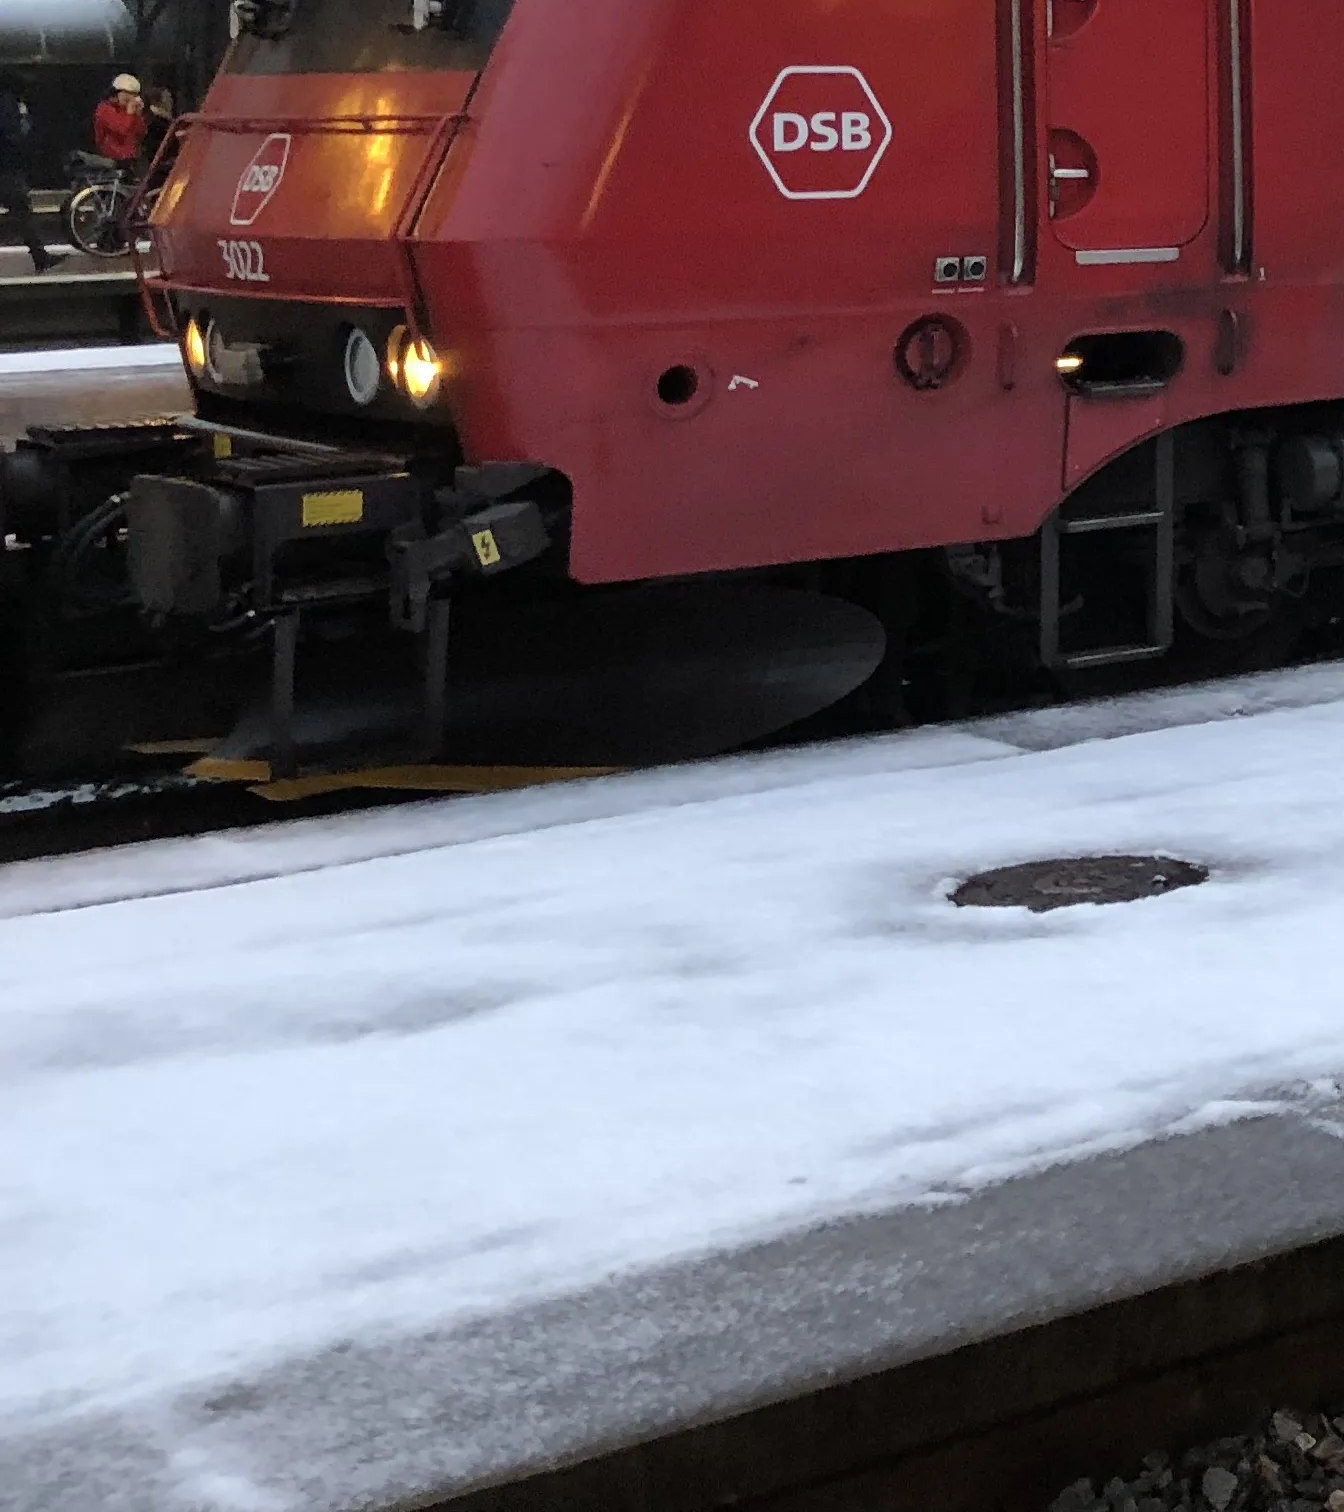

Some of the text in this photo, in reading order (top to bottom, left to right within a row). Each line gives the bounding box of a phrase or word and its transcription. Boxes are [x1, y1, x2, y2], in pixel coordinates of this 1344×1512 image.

[773, 111, 872, 152] DSB
[242, 164, 279, 192] DSB
[217, 240, 271, 282] 3022
